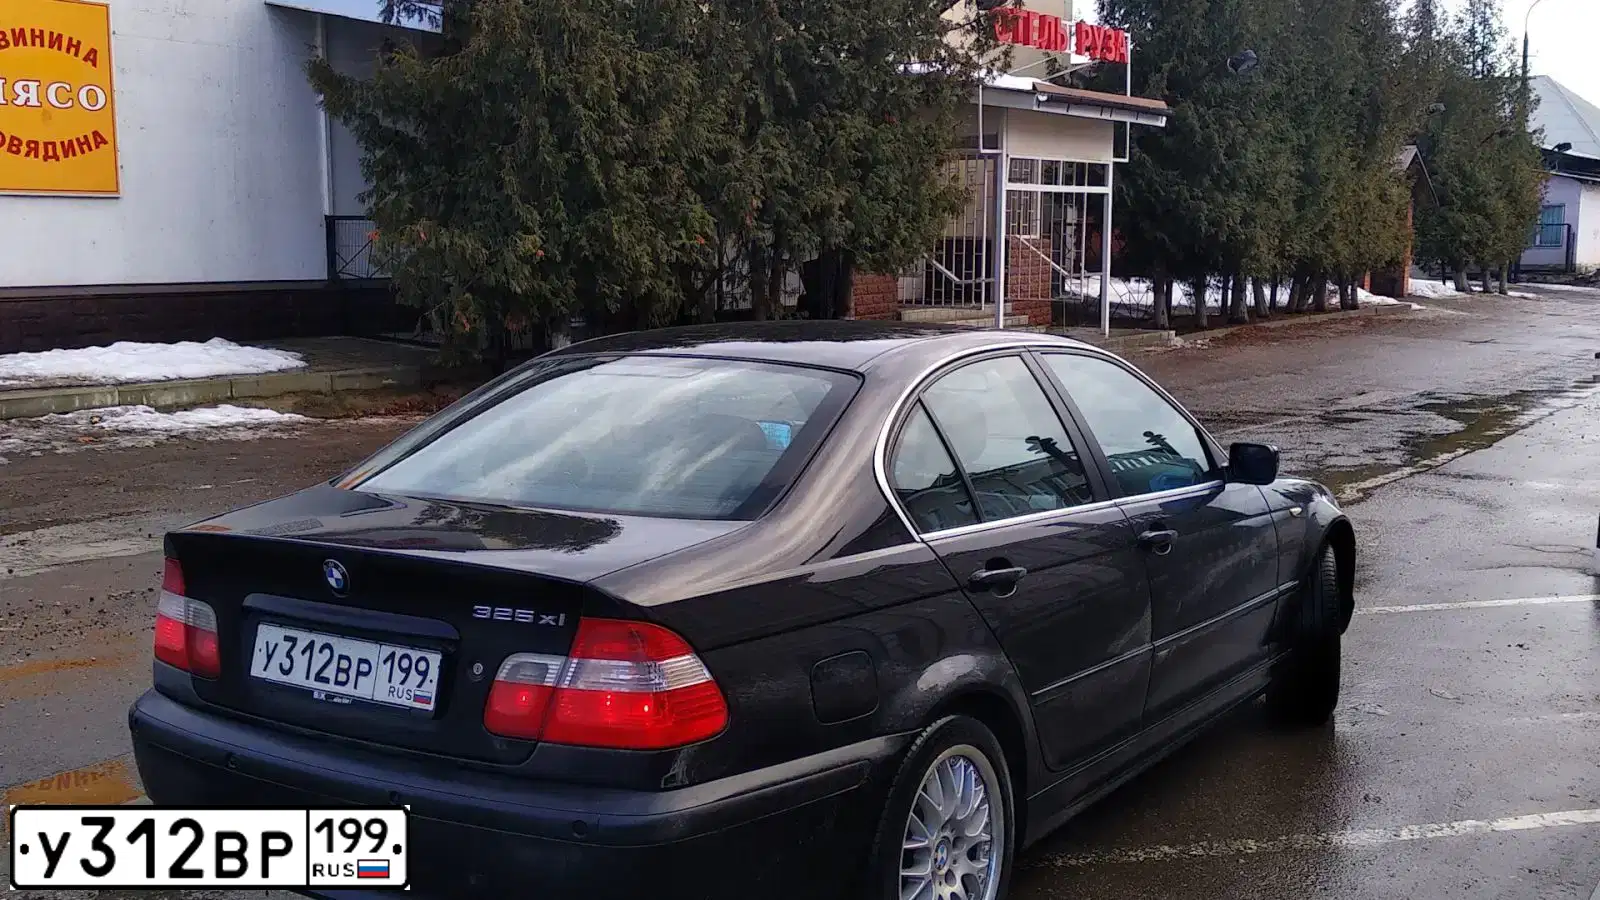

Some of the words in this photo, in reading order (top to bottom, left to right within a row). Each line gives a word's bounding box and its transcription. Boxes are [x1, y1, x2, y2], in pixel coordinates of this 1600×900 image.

[1075, 22, 1129, 63] РУЗА
[0, 78, 107, 111] ЯСО
[383, 651, 430, 688] 199
[388, 685, 412, 700] RUS
